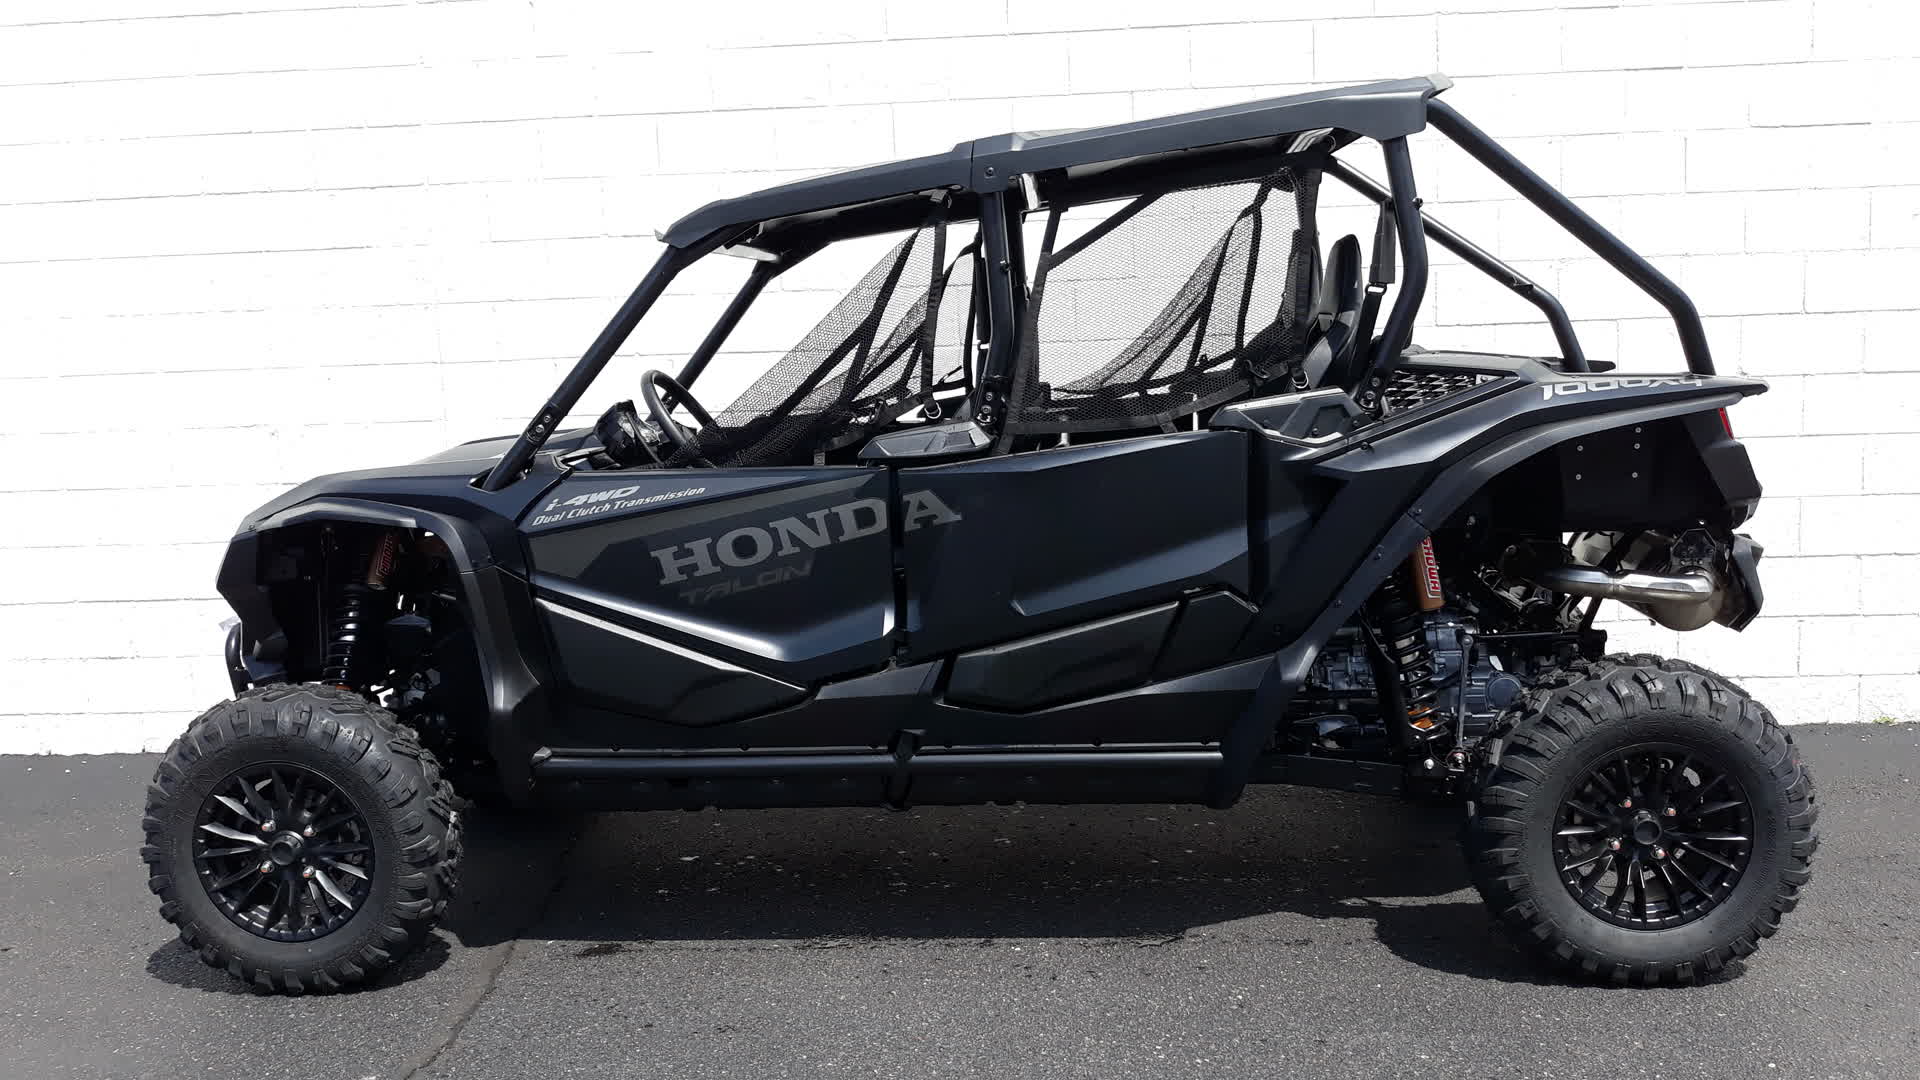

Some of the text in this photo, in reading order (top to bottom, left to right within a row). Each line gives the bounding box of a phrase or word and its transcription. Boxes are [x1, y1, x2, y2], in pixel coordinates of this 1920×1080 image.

[532, 487, 707, 526] Dual Clutch Transmission
[544, 485, 640, 512] i-4WD
[649, 489, 962, 585] HONDA
[680, 558, 814, 605] TALON
